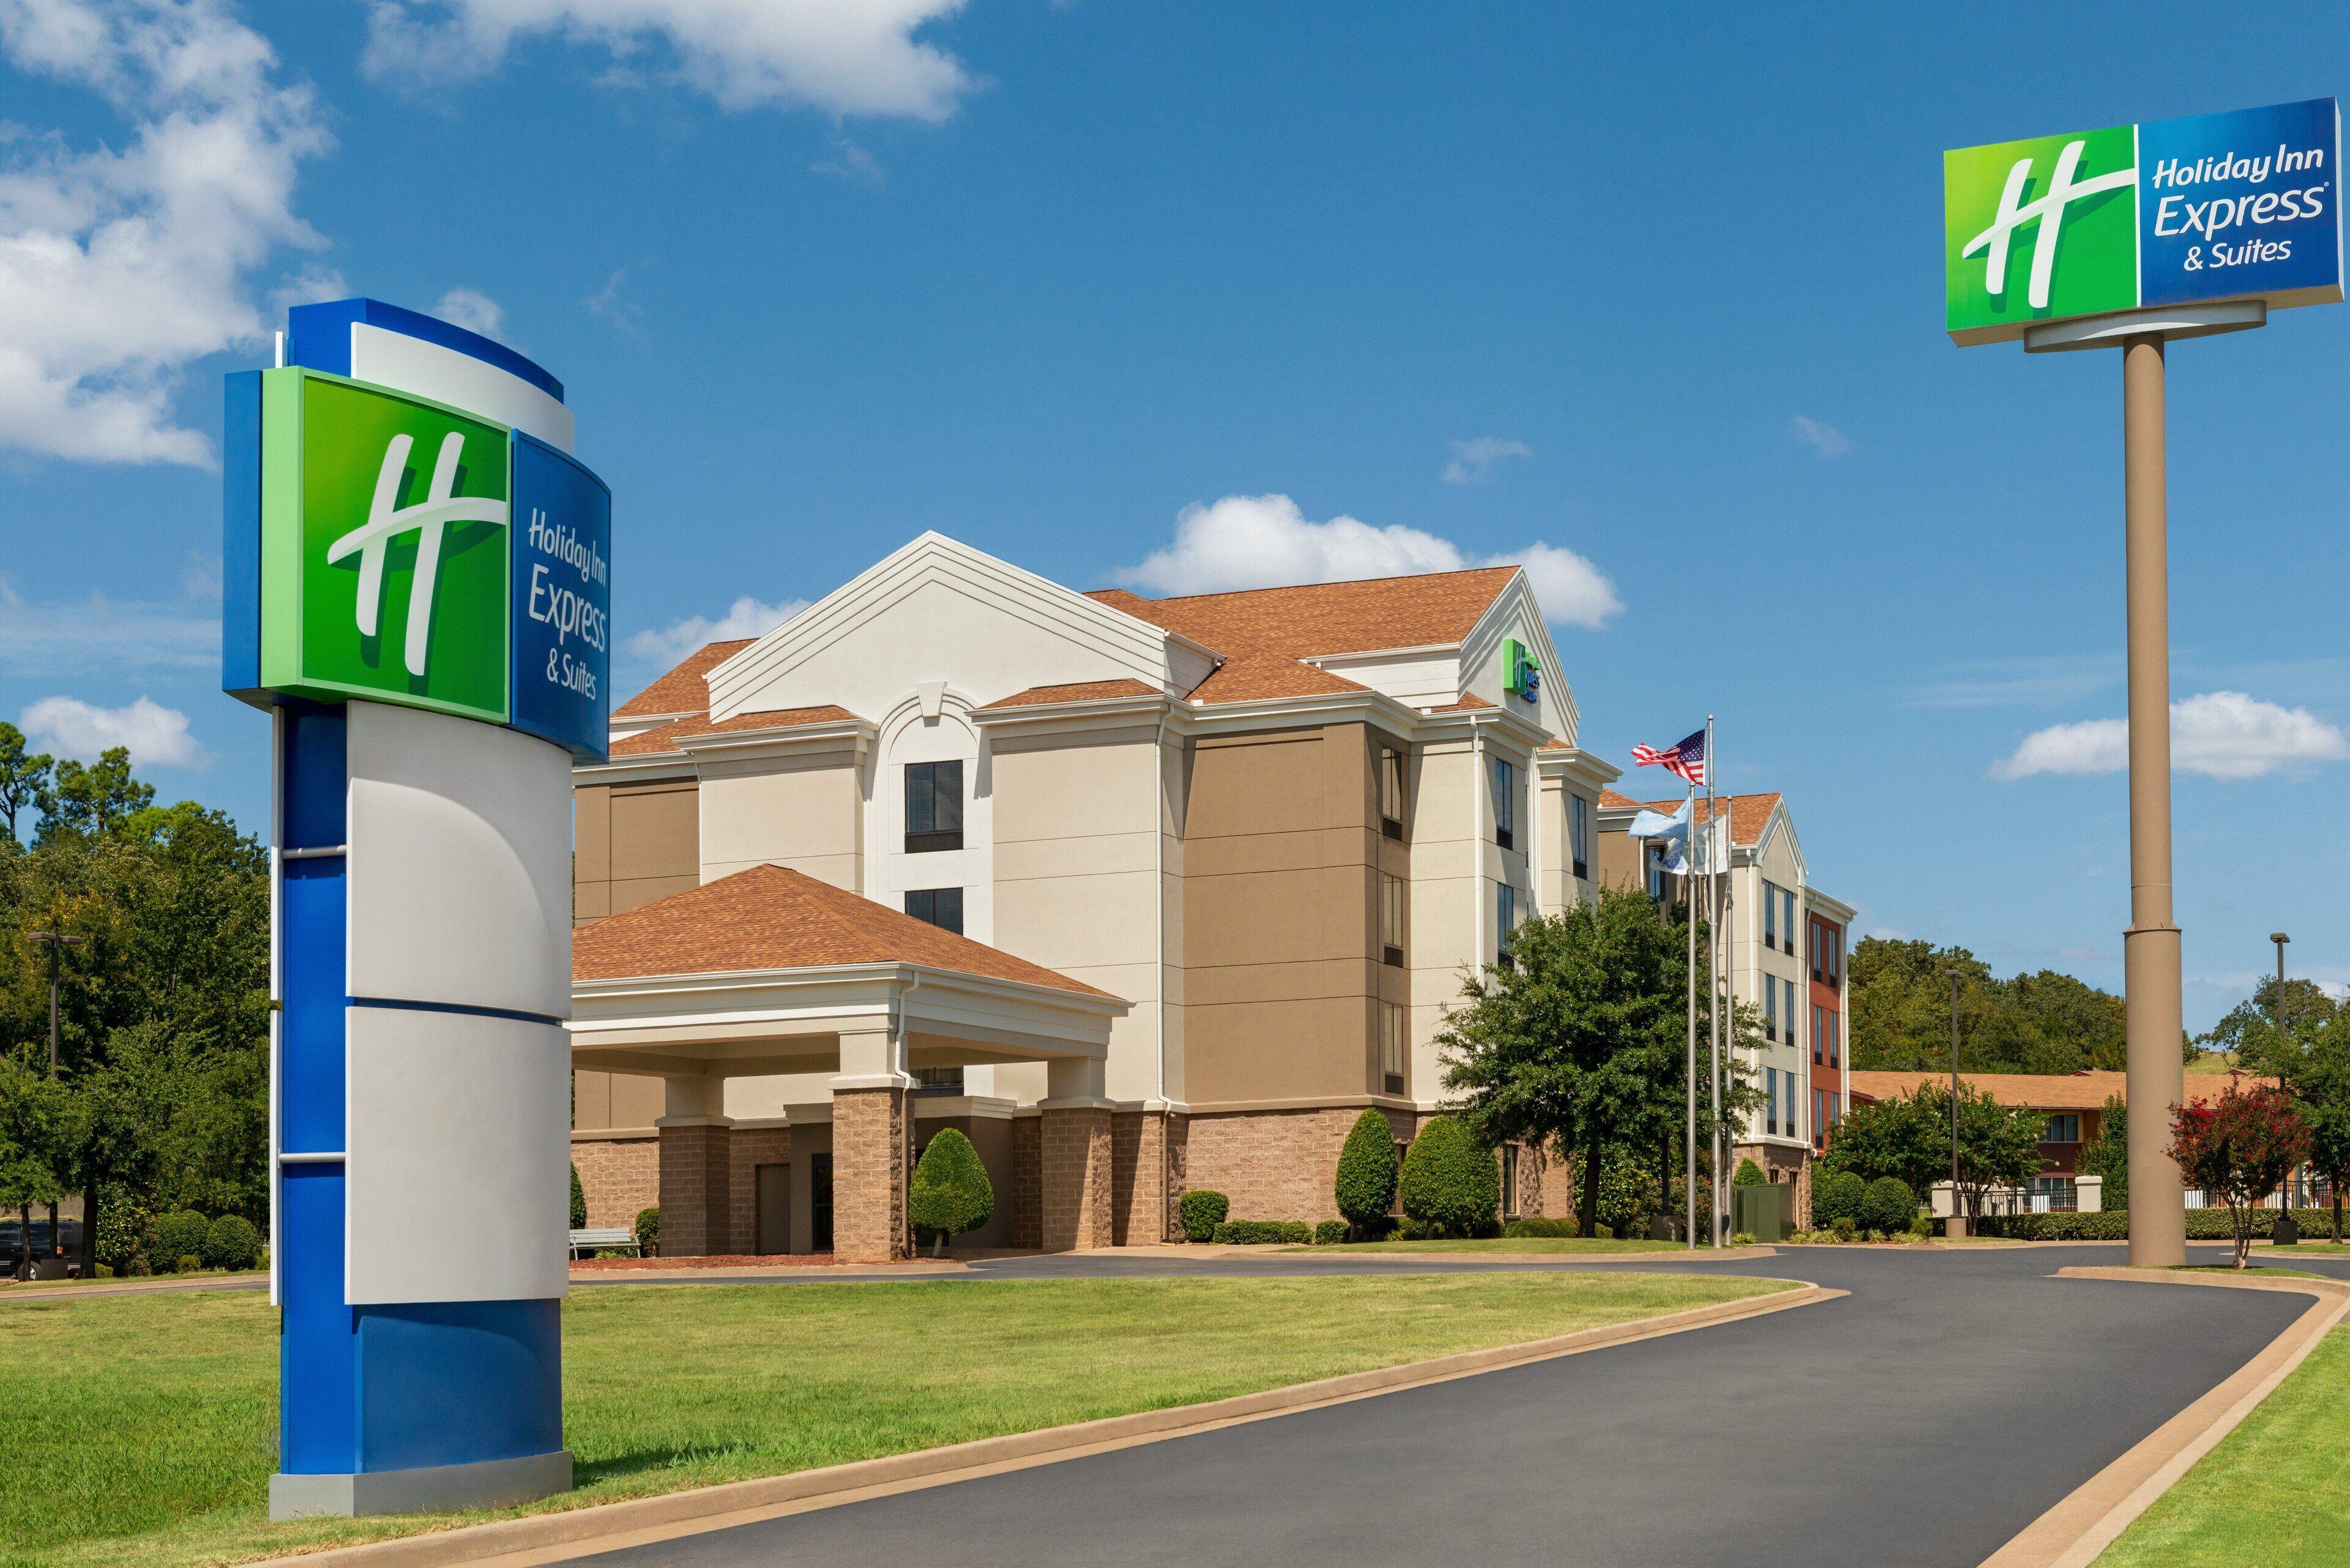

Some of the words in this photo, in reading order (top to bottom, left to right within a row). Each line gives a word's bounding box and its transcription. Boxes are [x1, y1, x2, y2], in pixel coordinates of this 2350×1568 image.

[2152, 152, 2271, 189] Holiday
[2275, 144, 2324, 173] Inn
[2184, 246, 2203, 271] &
[2209, 239, 2291, 268] Suites
[528, 507, 591, 583] Holiday
[591, 540, 606, 587] Inn
[529, 562, 606, 653] Express
[546, 648, 558, 683] &
[561, 653, 597, 700] Suites
